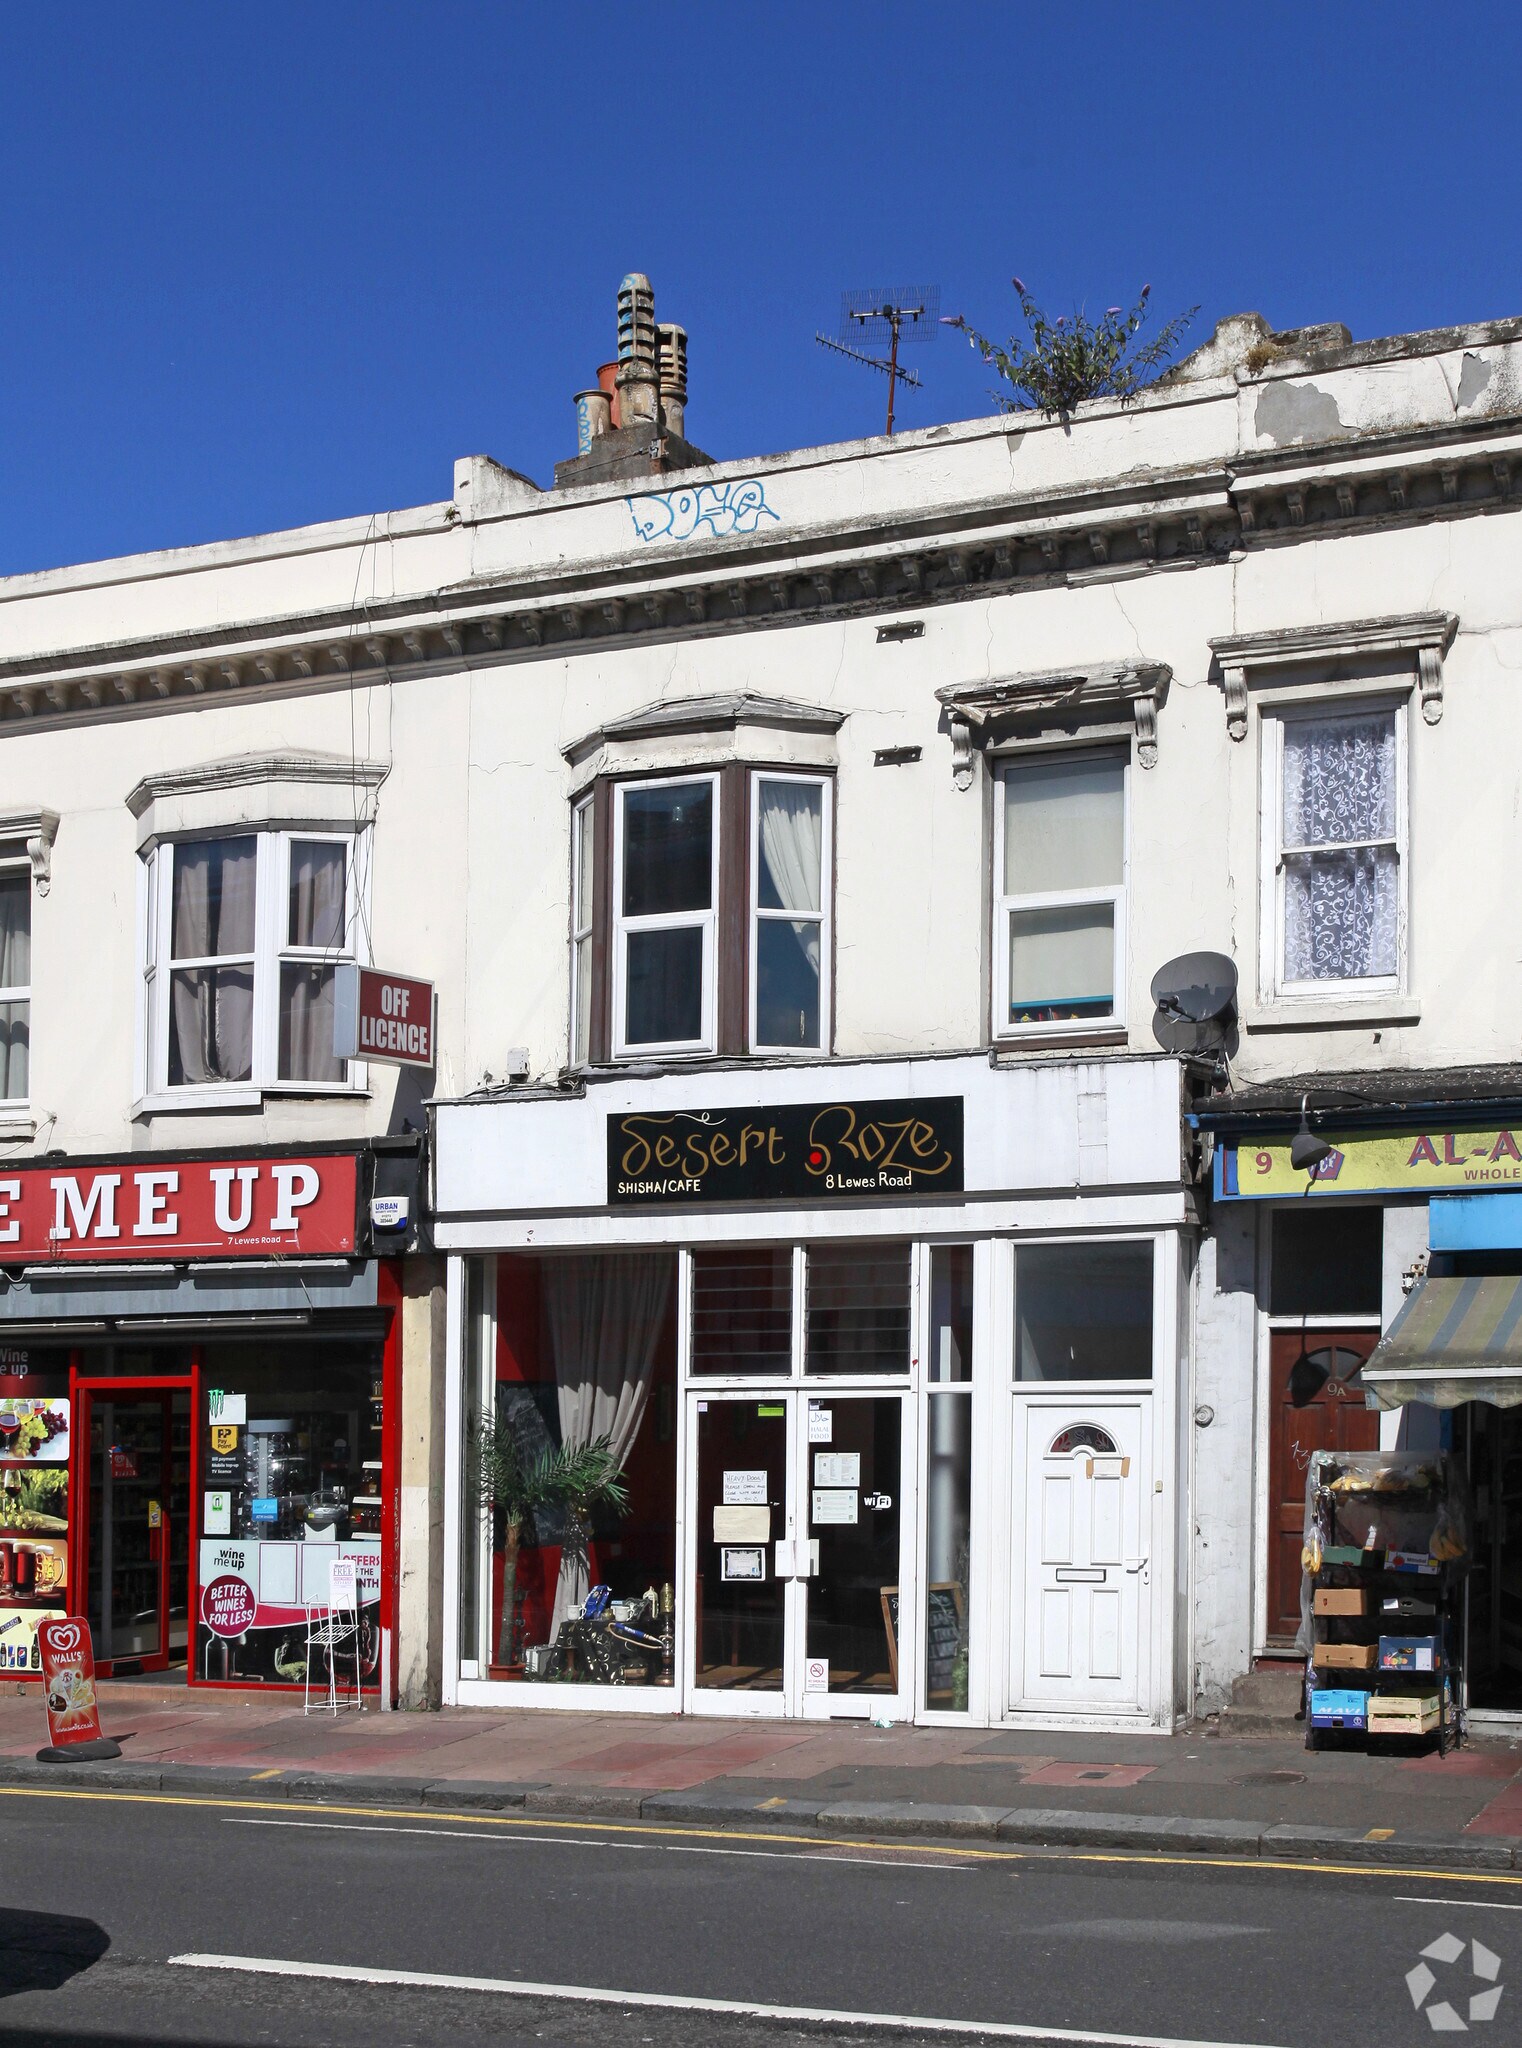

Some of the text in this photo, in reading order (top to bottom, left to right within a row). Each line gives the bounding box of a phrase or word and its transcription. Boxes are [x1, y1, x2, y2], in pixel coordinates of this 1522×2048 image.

[381, 985, 410, 1018] OFF
[361, 1015, 428, 1055] LICENCE
[1255, 1152, 1273, 1175] 9
[825, 1170, 912, 1189] 8 Lewes Road
[1464, 1167, 1521, 1181] WHOLE
[617, 1179, 701, 1194] SHISHA/CAFE
[49, 1171, 179, 1240] ME
[210, 1164, 320, 1234] UP
[375, 1202, 398, 1210] URBAN
[228, 1236, 281, 1245] 7 Lewes Road
[11, 1364, 28, 1379] up
[219, 1548, 245, 1560] wine
[213, 1557, 245, 1571] me up
[360, 1568, 374, 1576] THE
[211, 1584, 247, 1600] BETTER
[214, 1598, 245, 1613] WINES
[209, 1609, 253, 1626] FOR LESS
[52, 1652, 82, 1663] WALL'S
